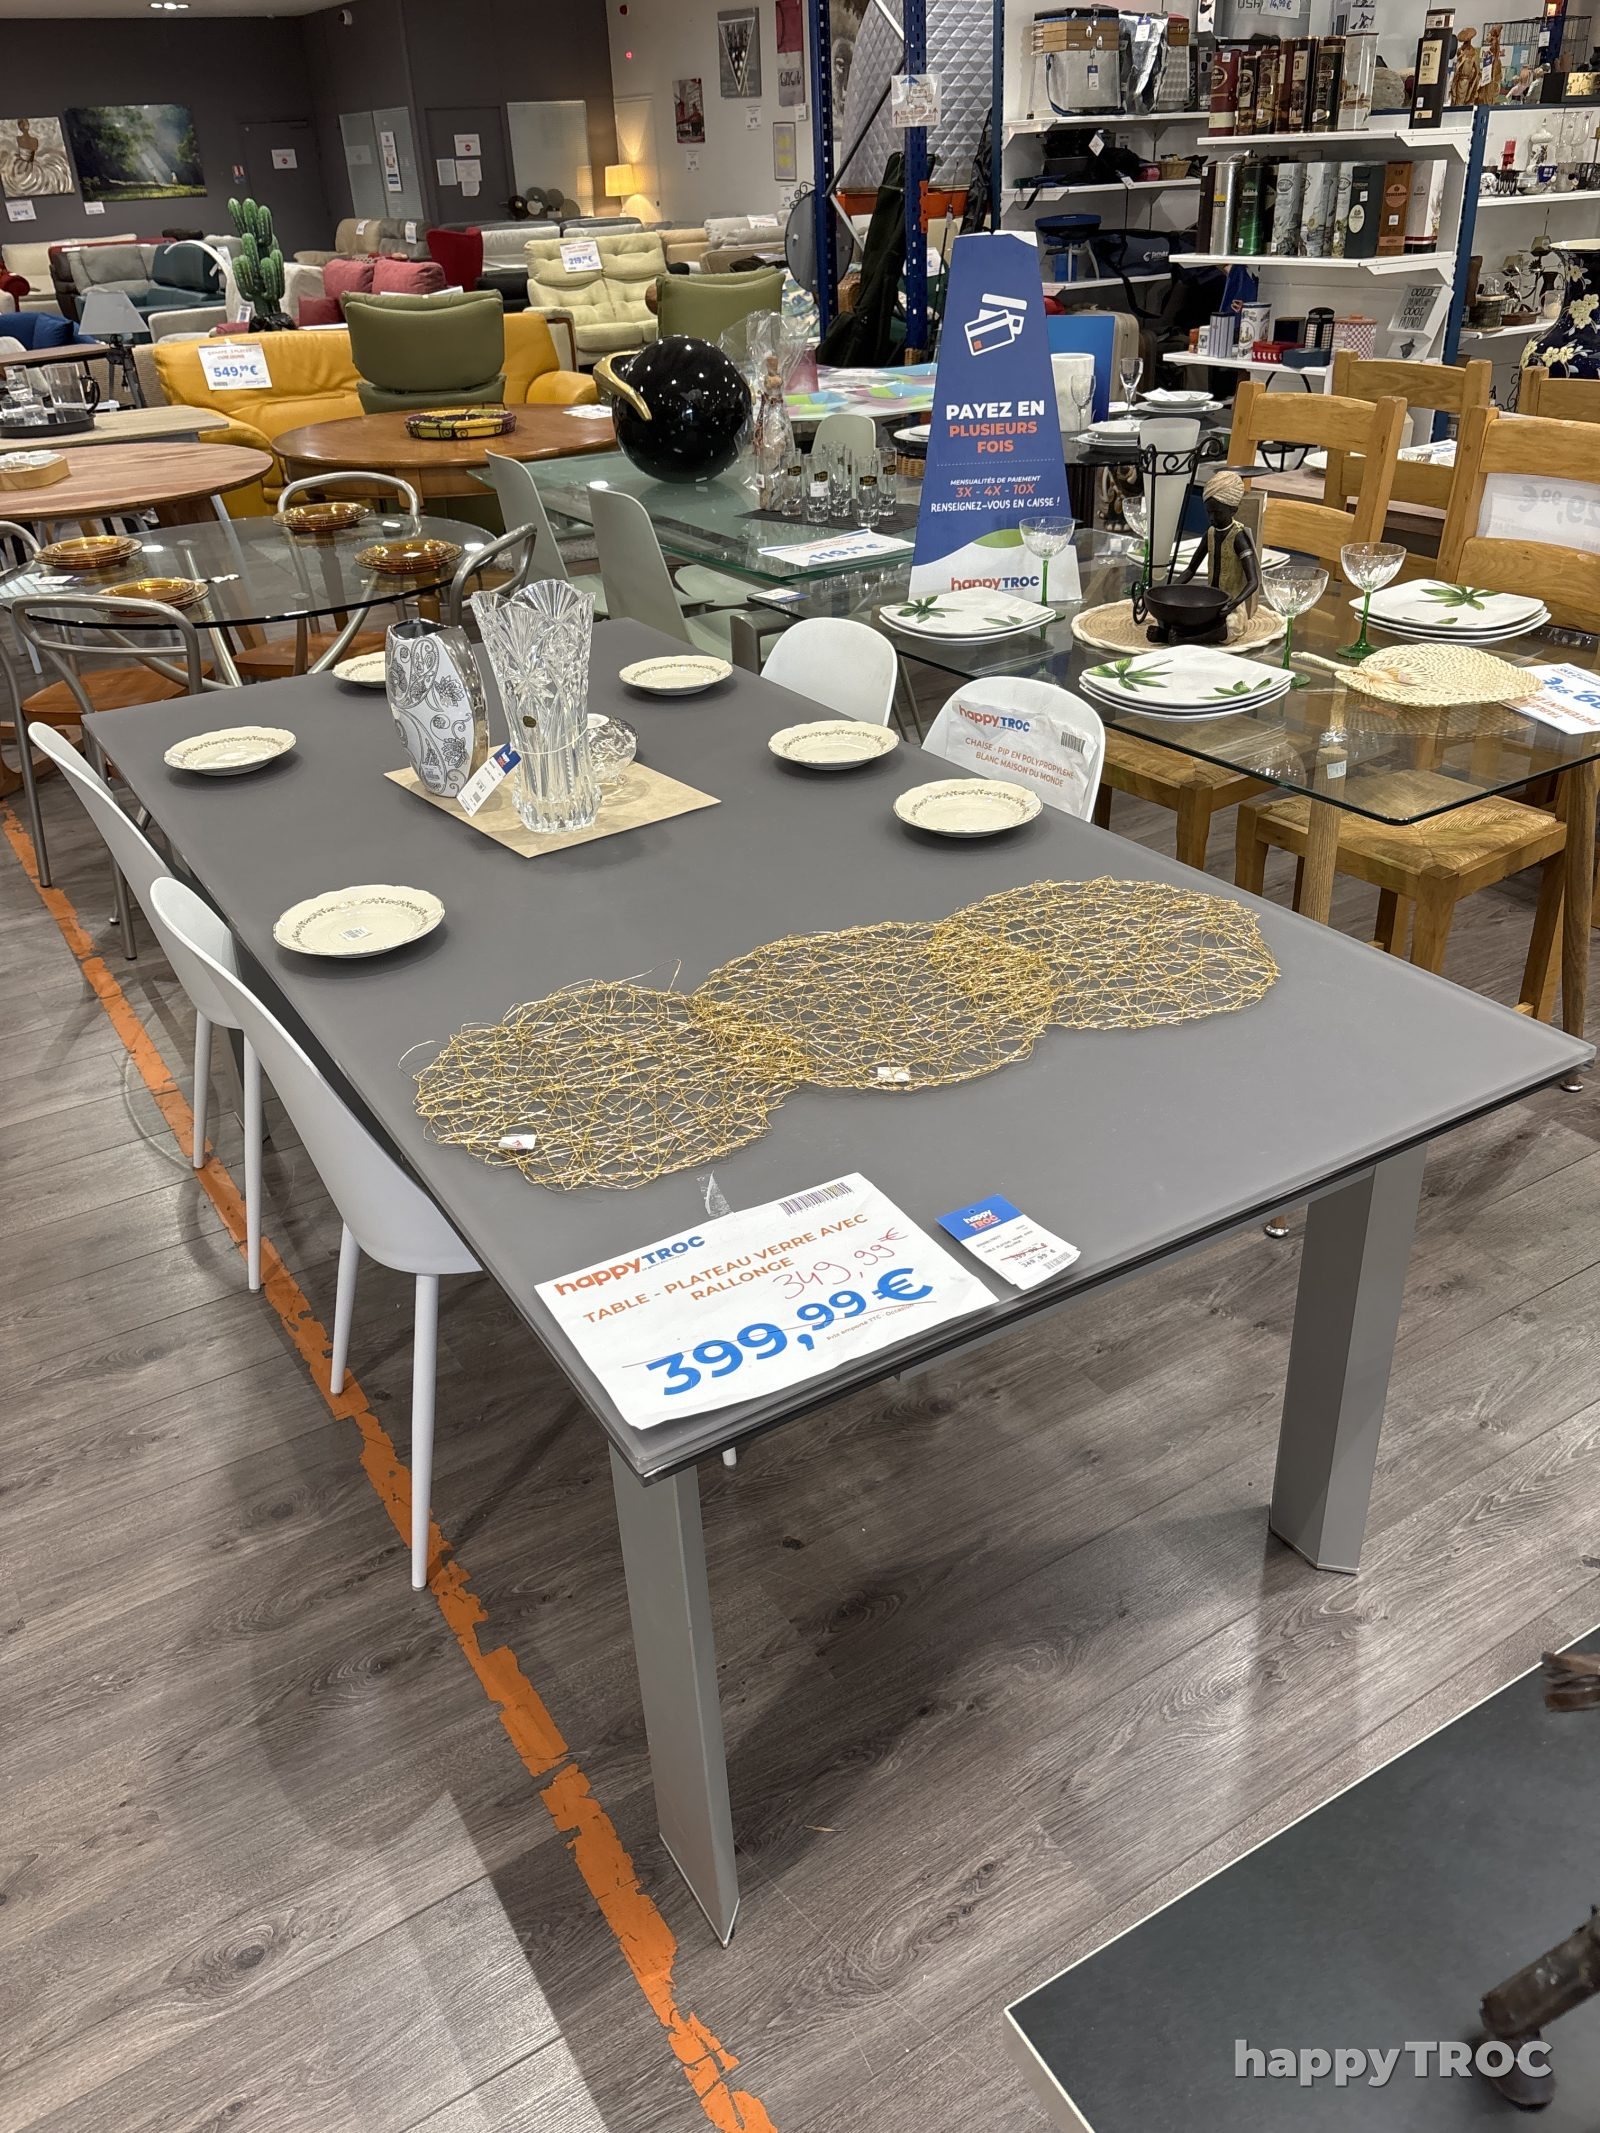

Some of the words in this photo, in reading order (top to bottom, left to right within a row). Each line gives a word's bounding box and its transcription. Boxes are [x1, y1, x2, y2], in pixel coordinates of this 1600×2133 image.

[946, 402, 1012, 420] PAYEZ
[1017, 400, 1045, 416] EN
[949, 421, 1038, 438] PLUSIEURS
[977, 440, 1014, 453] FOIS
[1007, 475, 1041, 484] PAIEMENT
[956, 487, 972, 498] 3X
[984, 485, 1001, 496] 4X
[1013, 484, 1035, 495] 10X
[931, 499, 1011, 513] RENSEIGNEZ-VOUS
[1013, 499, 1025, 508] EN
[1027, 497, 1054, 508] CAISSE
[958, 705, 1031, 733] happyTROC
[965, 737, 993, 750] CHAISE
[997, 746, 1010, 757] PIP
[1011, 752, 1021, 762] EN
[1022, 753, 1074, 779] POLYPROPYLENE
[975, 752, 1000, 765] BLANC
[1000, 760, 1028, 775] MAISON
[1029, 768, 1039, 778] DU
[1040, 773, 1064, 787] MONDE
[963, 1209, 992, 1225] happy
[970, 1215, 999, 1230] TROC
[554, 1235, 705, 1296] happyTROC
[583, 1293, 651, 1324] TABLE
[664, 1256, 752, 1294] PLATEAU
[753, 1231, 817, 1260] VERRE
[820, 1214, 868, 1237] AVEC
[690, 1257, 794, 1300] RALLONGE
[868, 1313, 882, 1324] TTC
